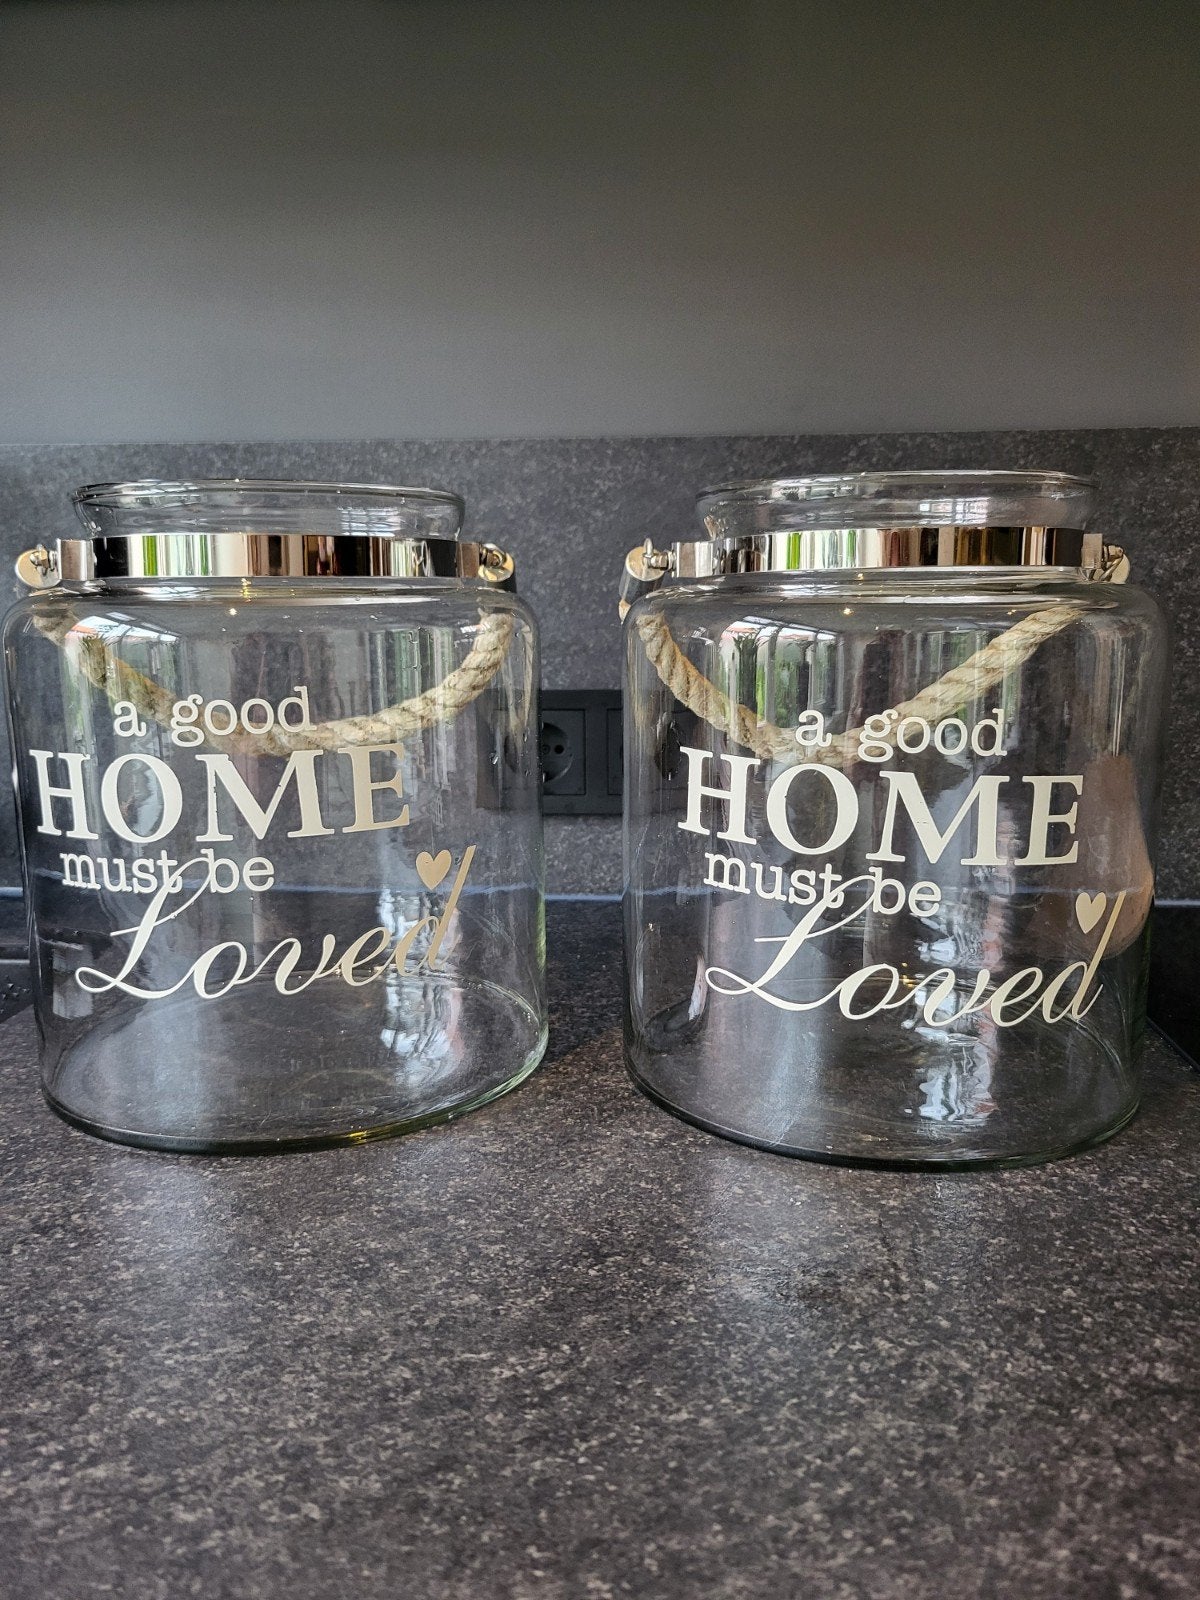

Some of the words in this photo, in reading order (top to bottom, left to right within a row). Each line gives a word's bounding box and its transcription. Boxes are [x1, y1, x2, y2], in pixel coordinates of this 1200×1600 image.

[113, 700, 146, 737] a
[171, 686, 316, 749] good
[795, 709, 833, 748] a
[857, 708, 1007, 763] good
[29, 742, 410, 844] HOME
[677, 746, 1084, 866] HOME
[60, 850, 182, 894] must
[201, 848, 274, 894] be
[704, 851, 845, 906] must
[868, 866, 942, 916] be
[75, 845, 477, 999] Loved
[705, 874, 1127, 1027] Loved
